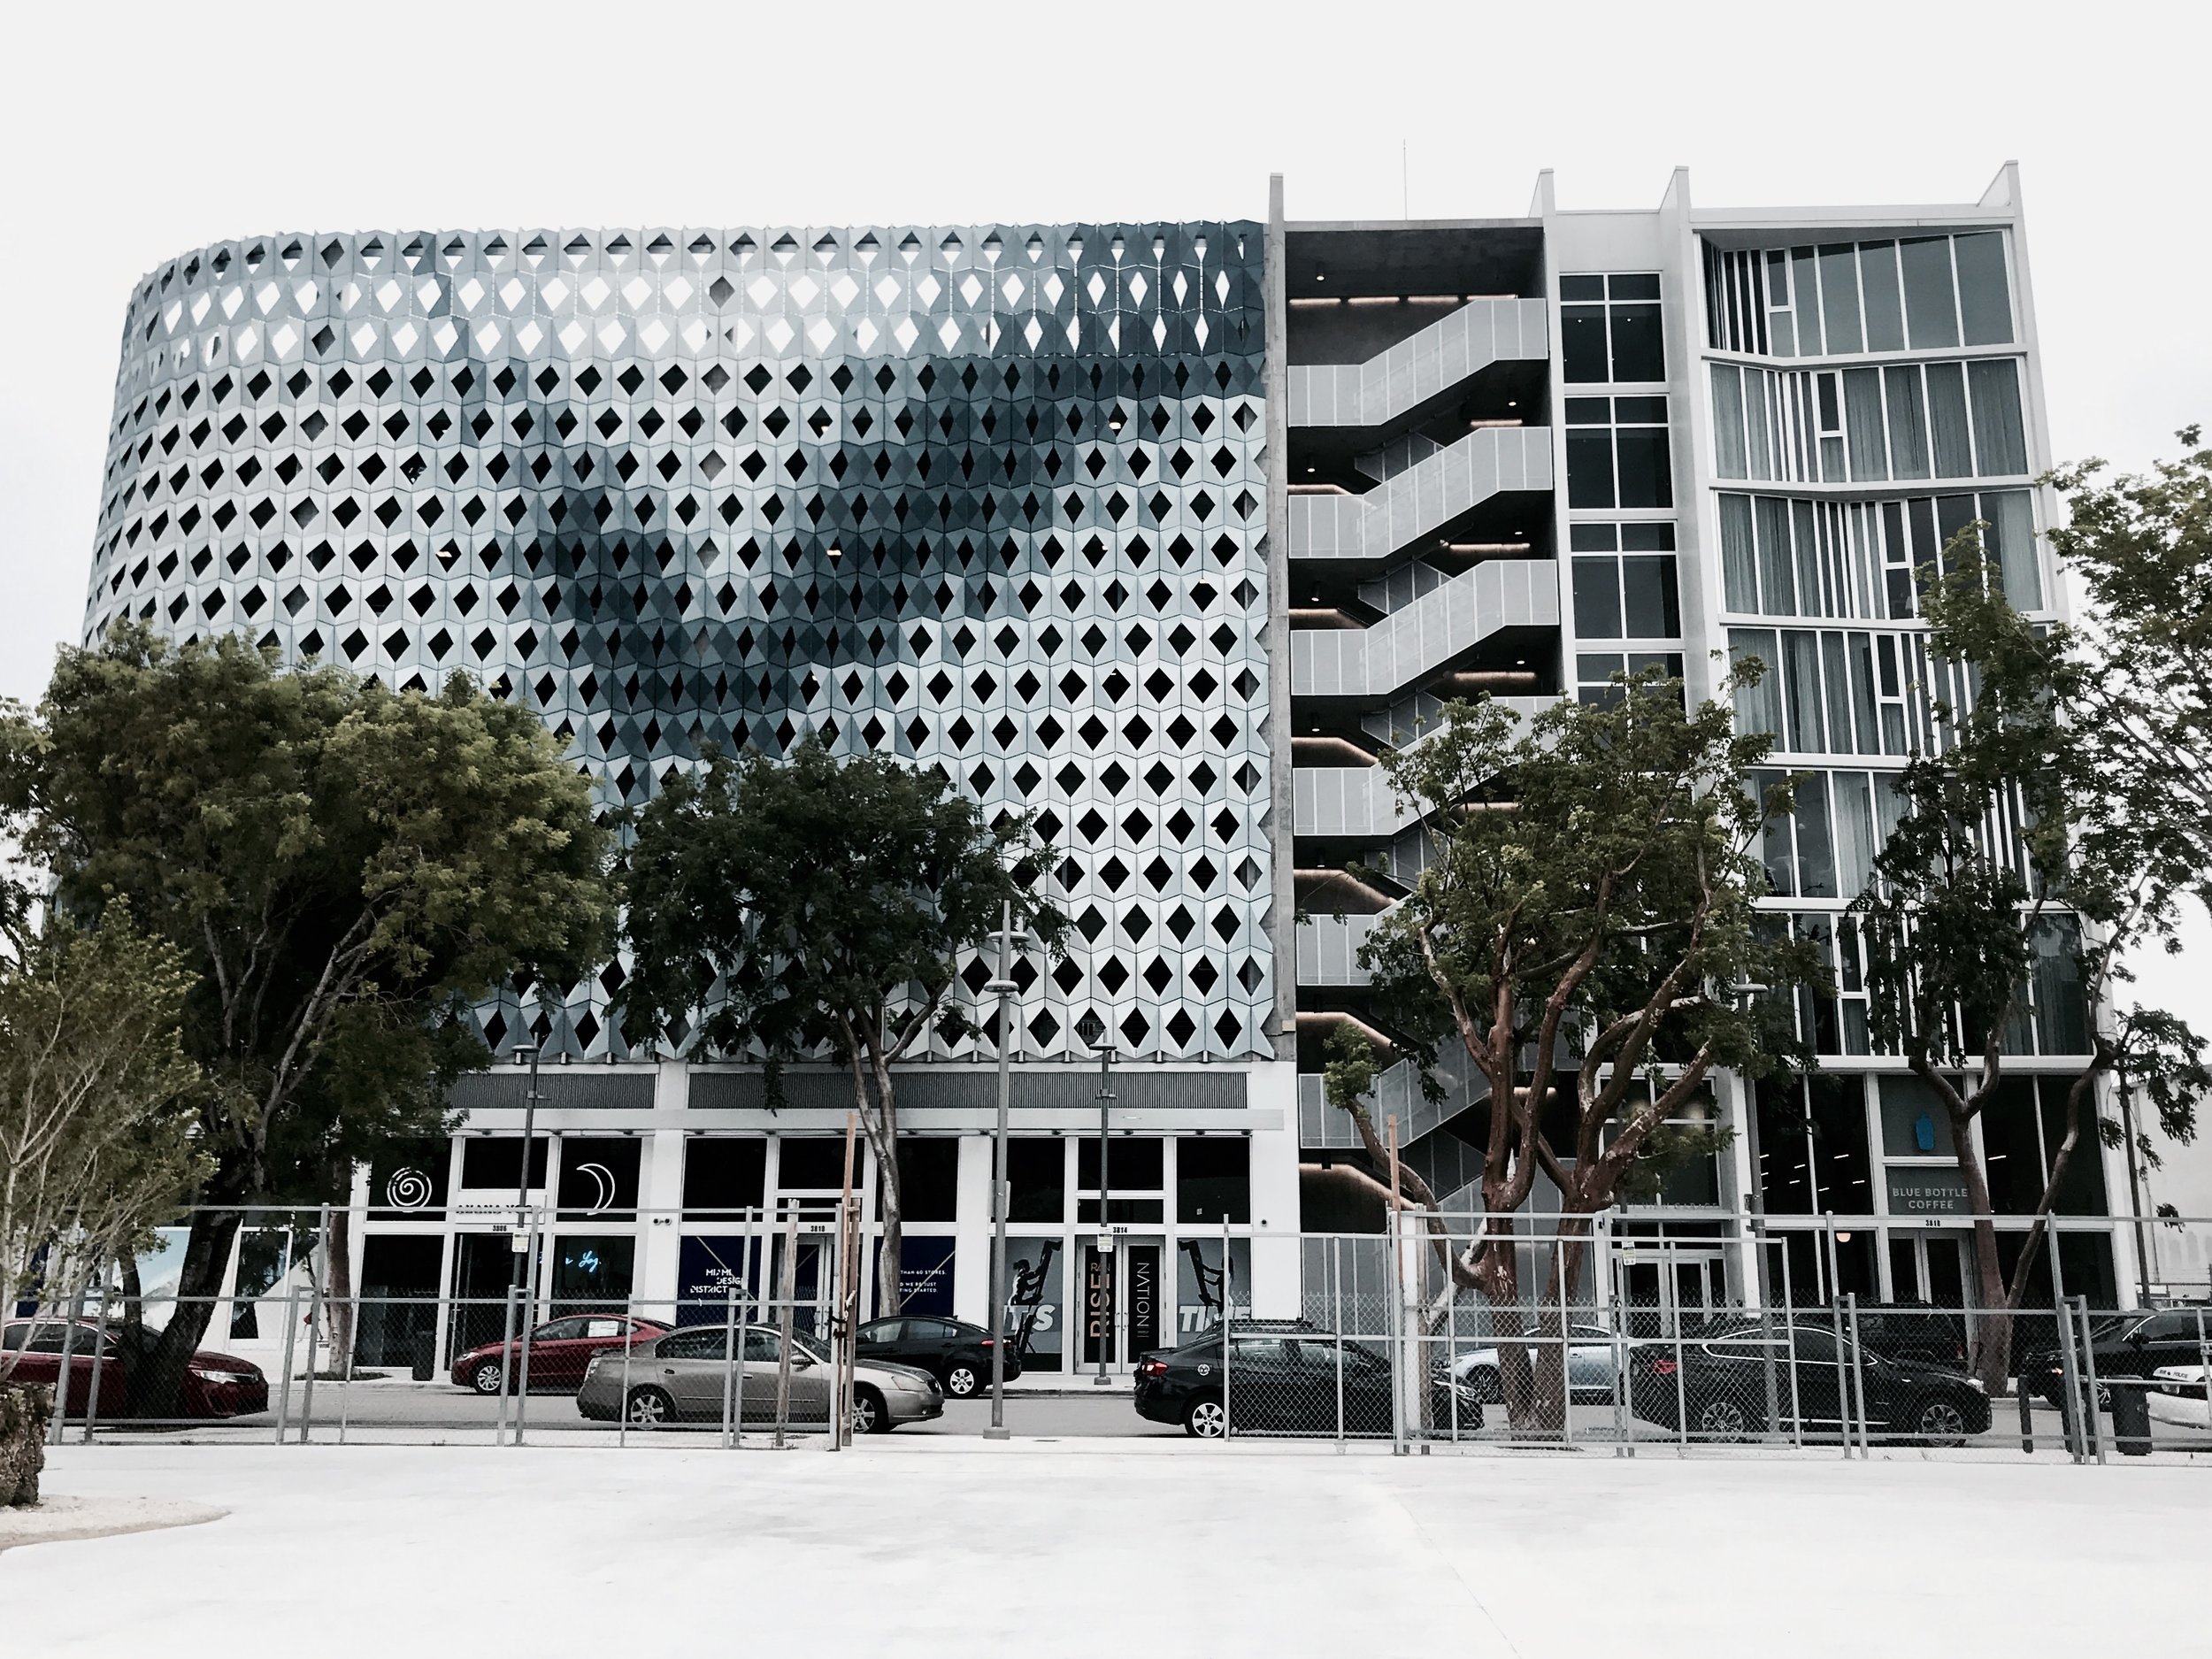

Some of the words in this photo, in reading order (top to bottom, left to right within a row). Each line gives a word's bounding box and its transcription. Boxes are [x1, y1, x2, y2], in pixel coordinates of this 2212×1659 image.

[1893, 1188, 1921, 1197] BLUE
[1925, 1188, 1968, 1197] BOTTLE
[1909, 1200, 1954, 1210] COFFEE
[705, 1268, 732, 1277] MIAMI
[690, 1285, 728, 1294] DISTRICT
[1136, 1263, 1150, 1326] NATION
[1089, 1273, 1110, 1338] RISE
